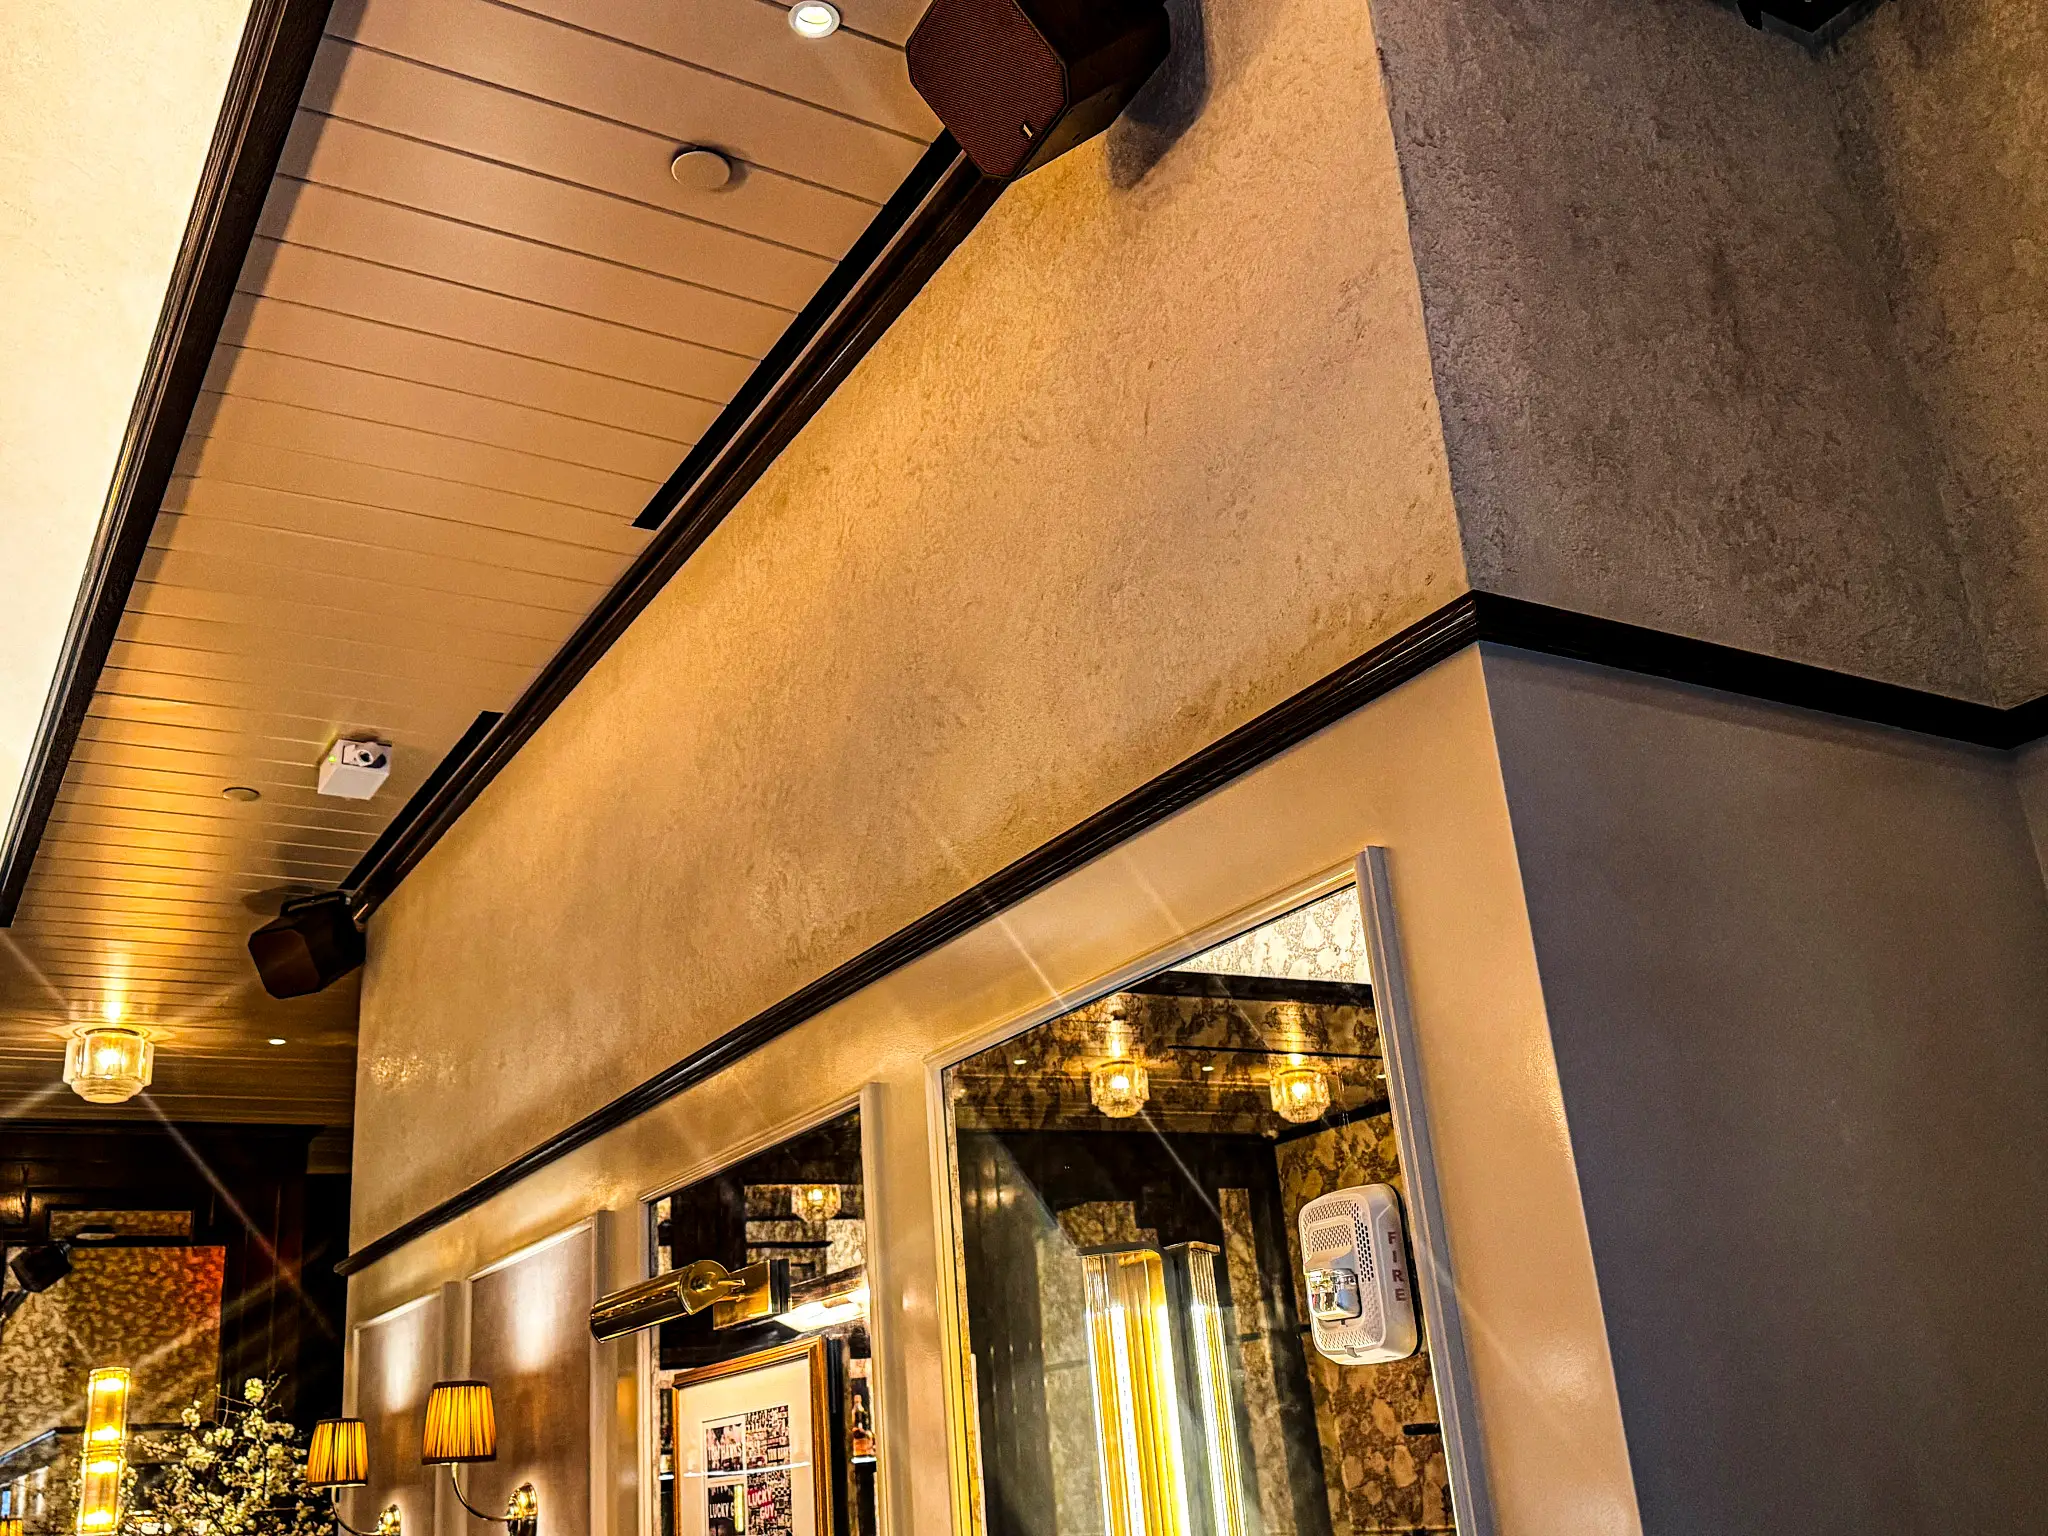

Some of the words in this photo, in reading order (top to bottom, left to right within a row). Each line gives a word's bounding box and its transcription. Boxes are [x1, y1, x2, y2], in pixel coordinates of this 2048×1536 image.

[1387, 1231, 1406, 1302] FIRE
[748, 1486, 772, 1506] LUCKY
[709, 1502, 729, 1518] LUCKY
[760, 1503, 775, 1519] GUY
